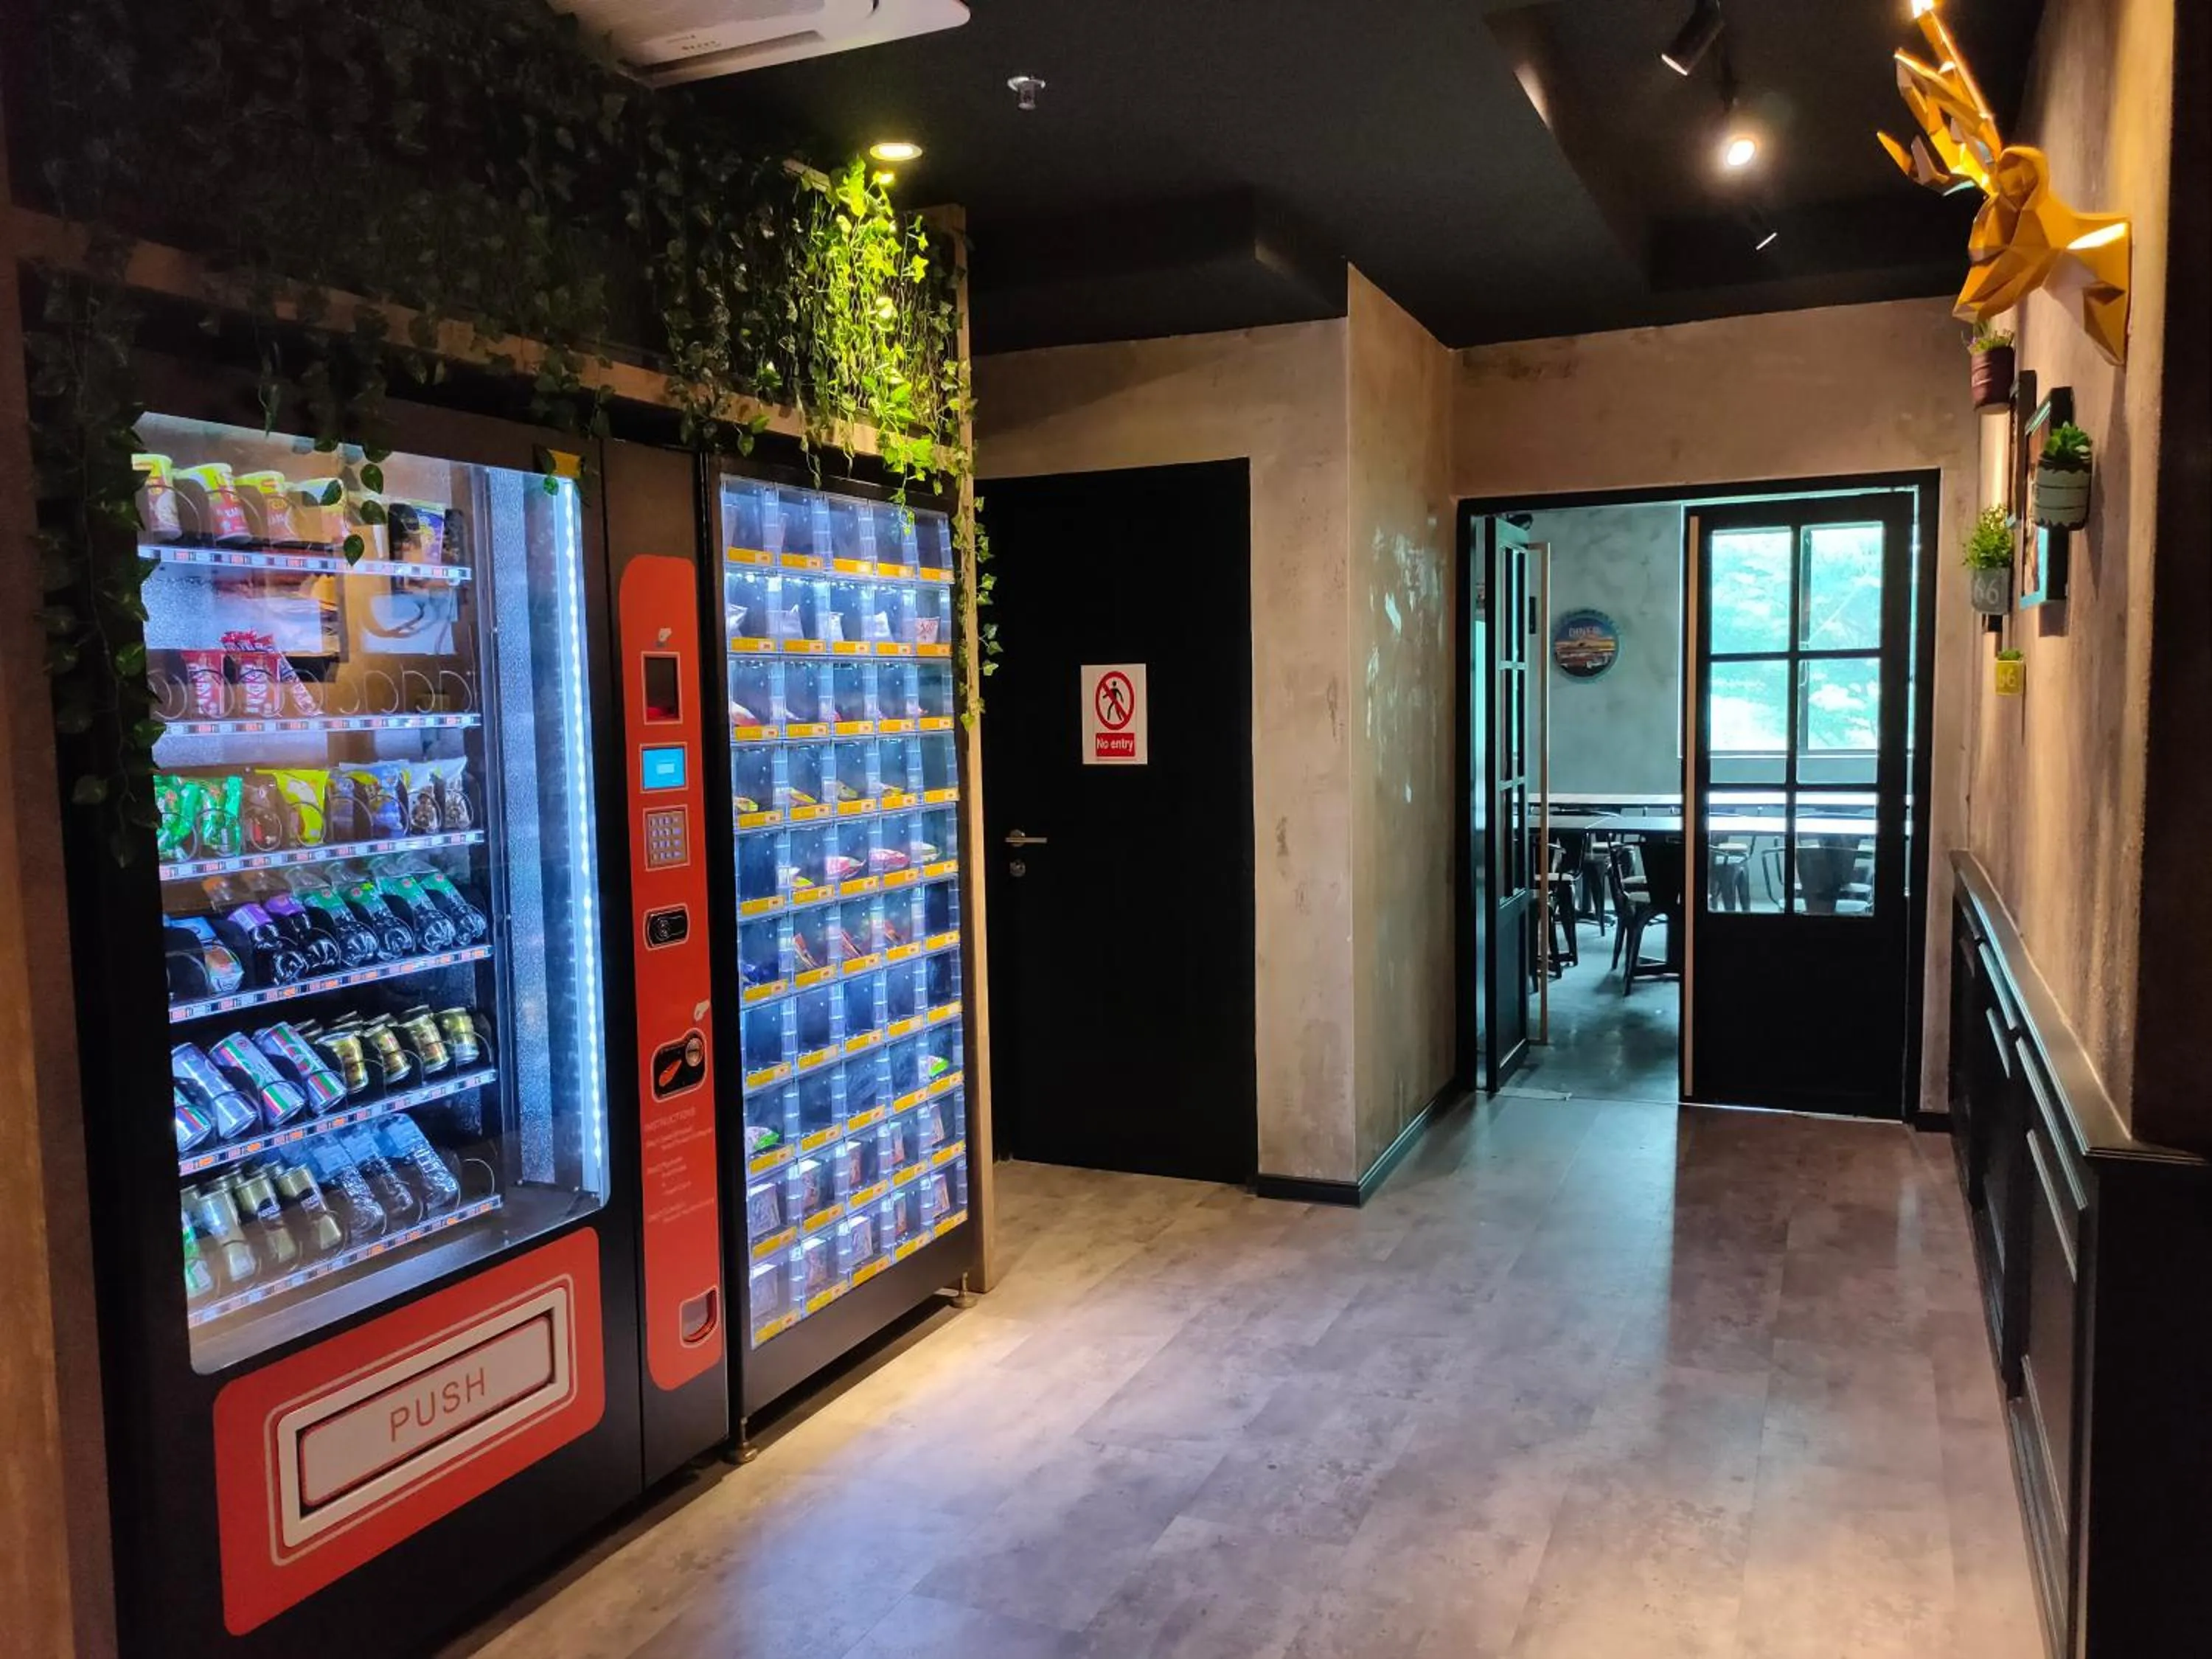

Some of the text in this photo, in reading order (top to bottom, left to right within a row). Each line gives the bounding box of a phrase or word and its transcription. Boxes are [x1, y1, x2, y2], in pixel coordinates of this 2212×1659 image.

[1096, 737, 1133, 752] No entry
[390, 1367, 485, 1441] PUSH
